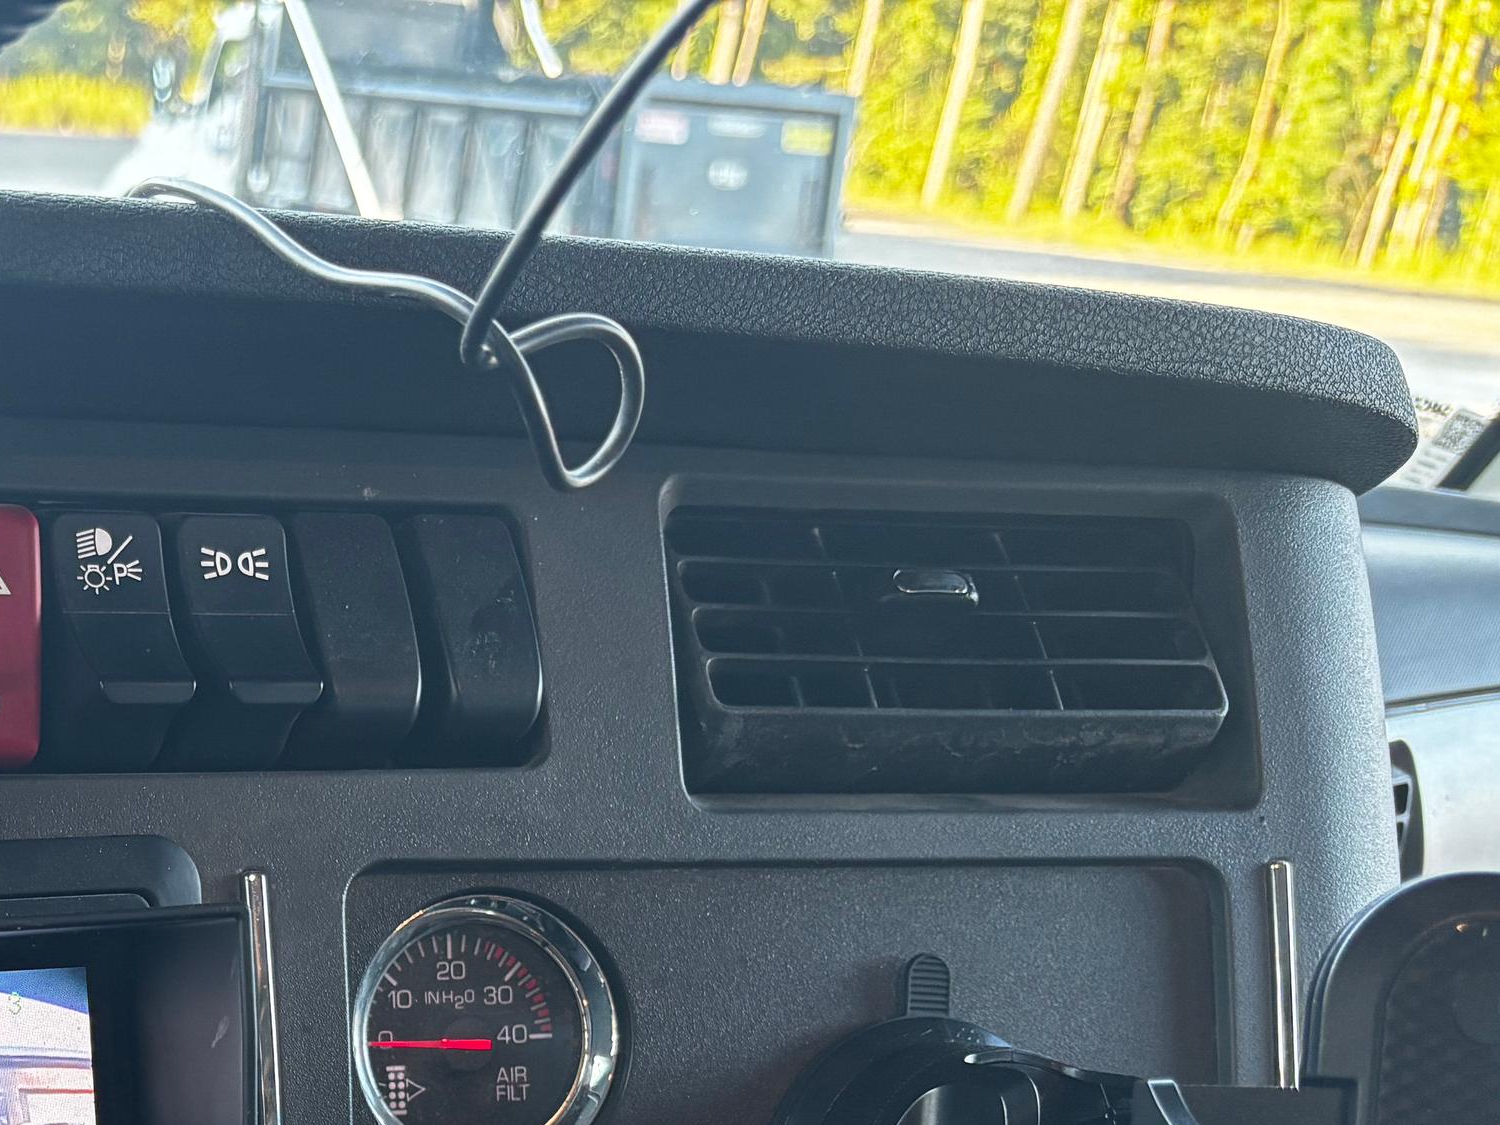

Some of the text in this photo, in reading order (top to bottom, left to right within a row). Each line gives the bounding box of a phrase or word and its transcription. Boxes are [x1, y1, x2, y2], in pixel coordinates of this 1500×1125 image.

[436, 961, 466, 981] 20
[388, 989, 413, 1009] 10
[483, 986, 513, 1005] 30
[378, 1030, 393, 1049] 0
[496, 1024, 528, 1045] 40
[496, 1066, 527, 1083] AIR
[496, 1083, 530, 1101] FILT
